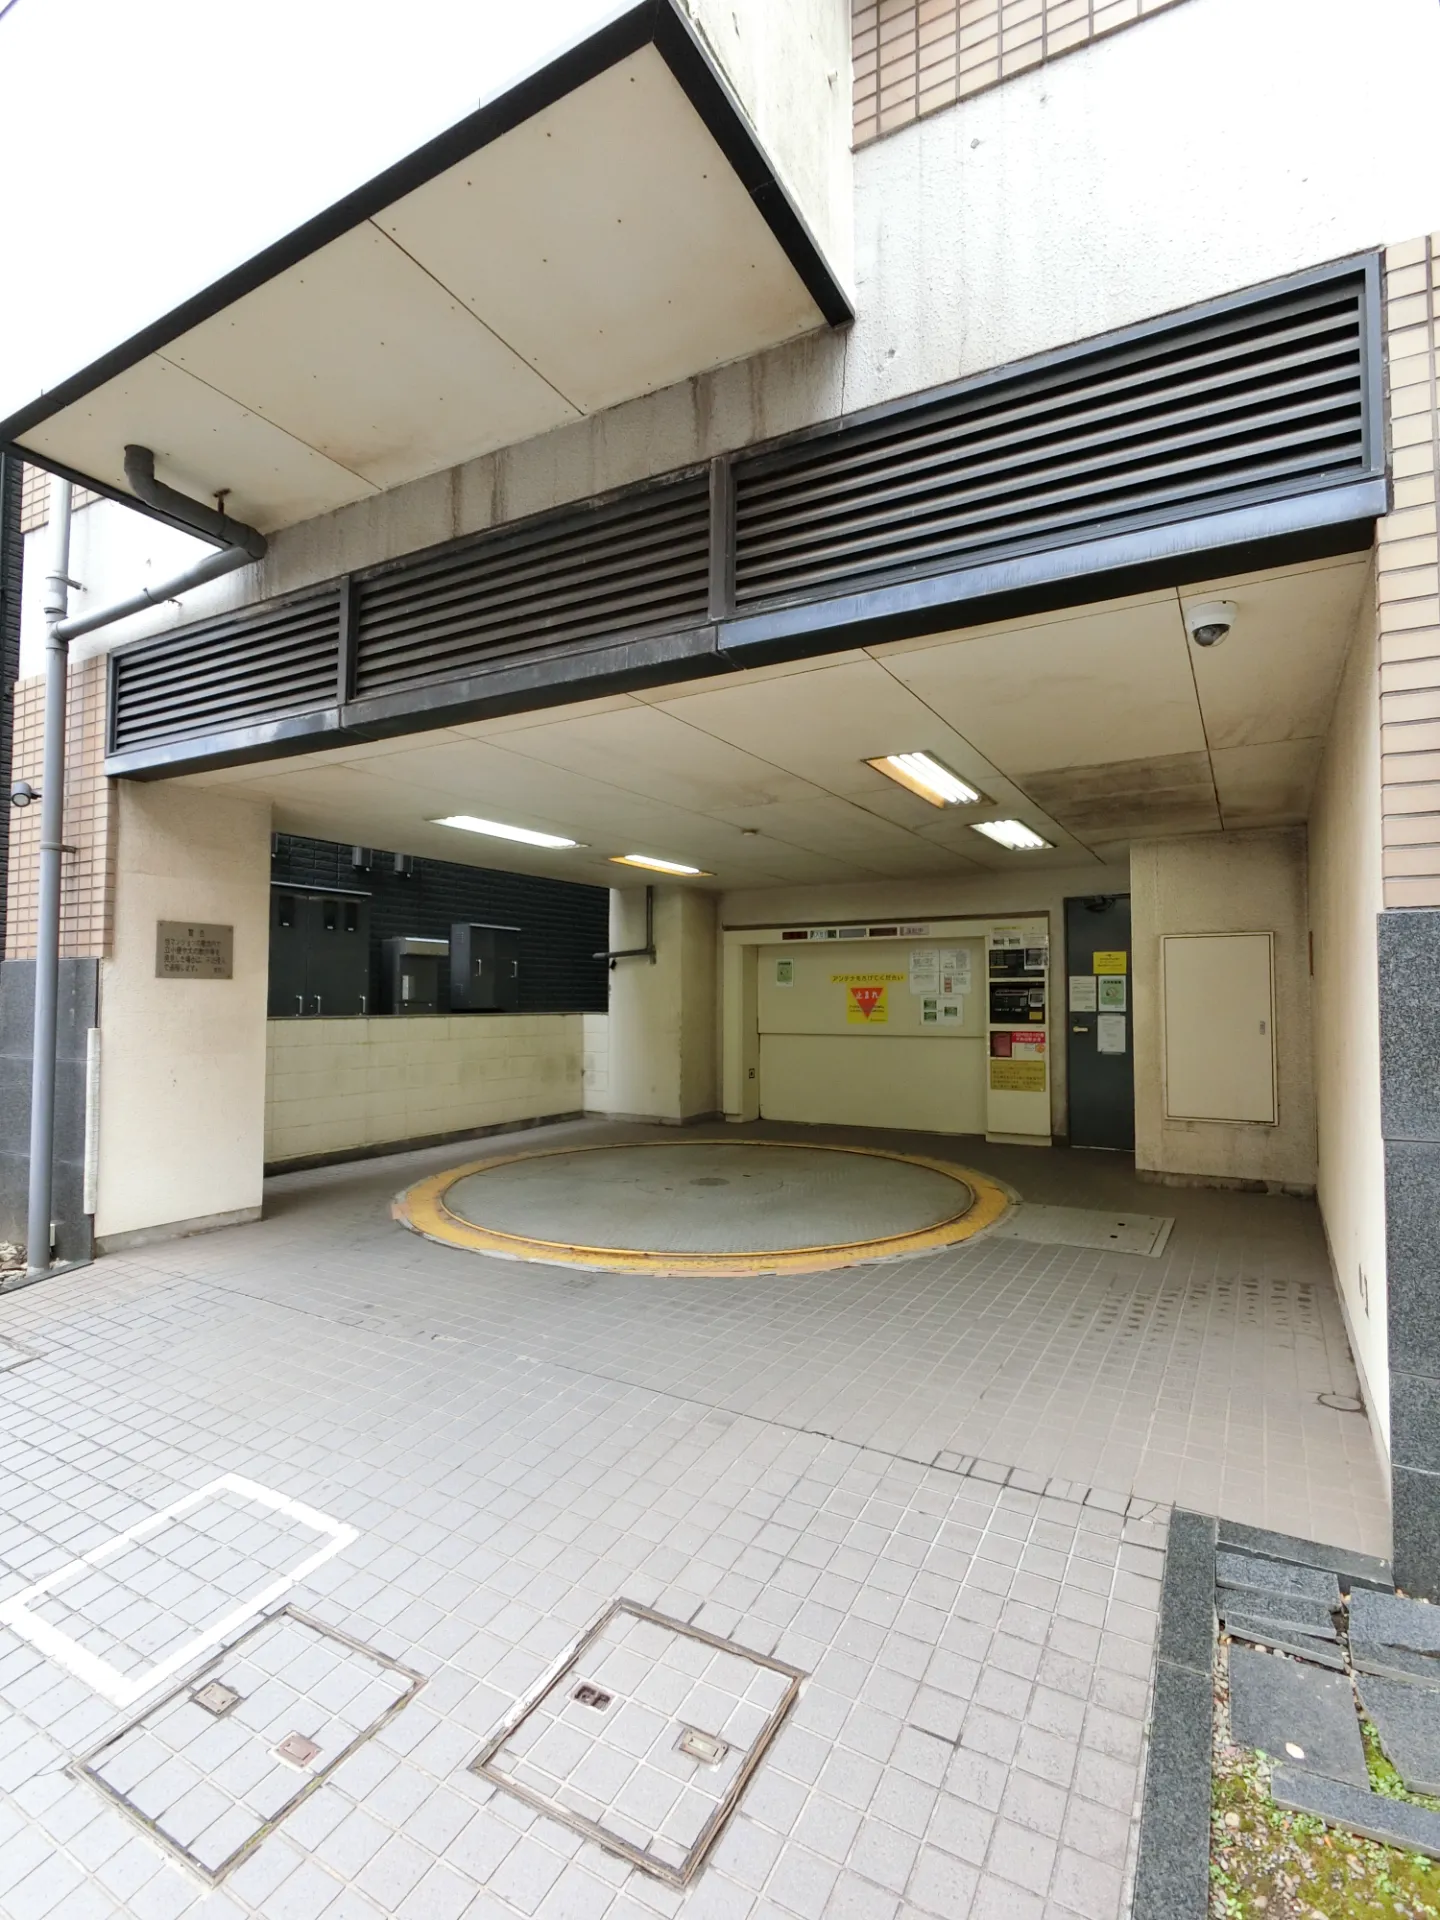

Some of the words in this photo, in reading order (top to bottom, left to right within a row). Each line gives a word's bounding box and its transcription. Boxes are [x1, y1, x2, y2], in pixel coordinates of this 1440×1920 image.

[832, 974, 904, 982] アンテナをさげてください
[855, 990, 879, 1000] 止まれ
